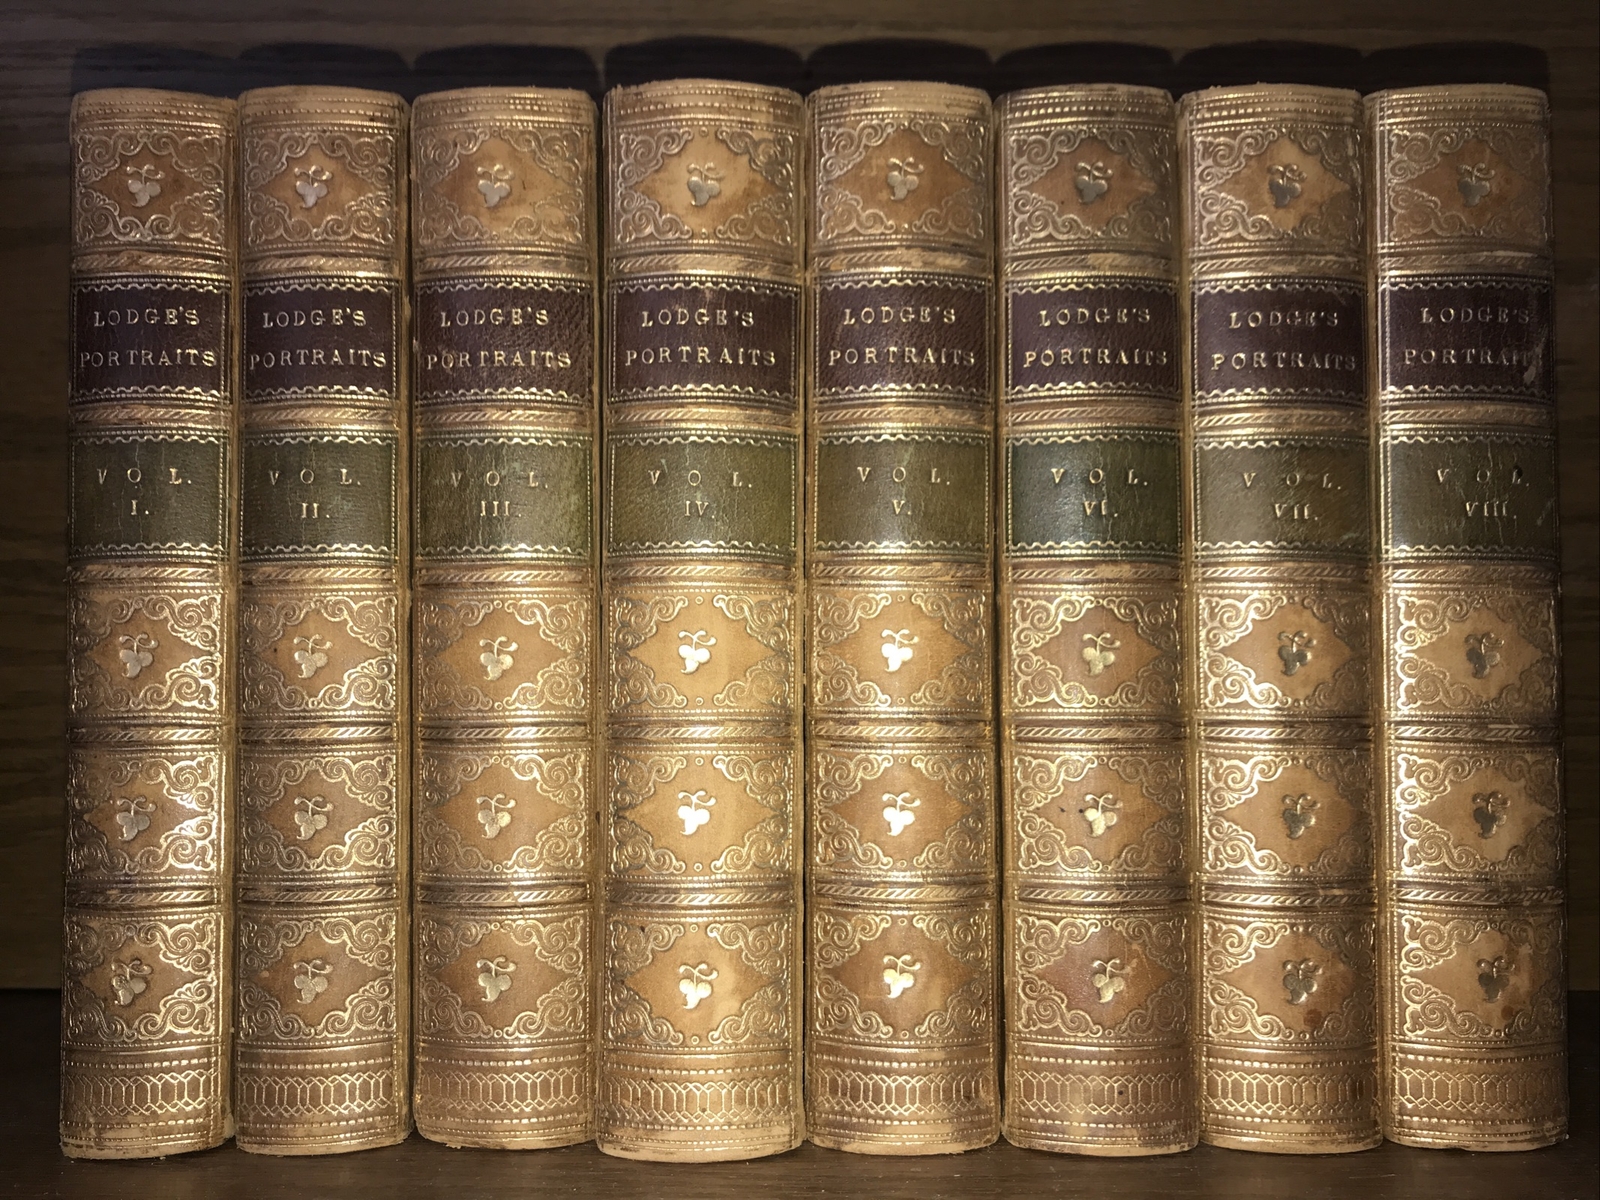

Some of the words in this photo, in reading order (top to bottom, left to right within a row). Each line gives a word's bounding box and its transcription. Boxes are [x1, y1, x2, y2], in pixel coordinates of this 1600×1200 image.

[94, 307, 200, 327] LODGE'S
[263, 308, 367, 328] LODGE'S
[440, 308, 550, 327] LODGE'S
[642, 310, 755, 327] LODGE'S
[843, 308, 956, 325] LODGE'S
[1040, 309, 1151, 326] LODGE'S
[1229, 312, 1338, 329] LODGE'S
[1421, 308, 1530, 324] LODGE'S
[80, 349, 217, 368] PORTRAITS
[250, 349, 386, 370] PORTRAITS
[427, 351, 572, 369] PORTRAITS
[625, 347, 775, 367] PORTRAITS
[829, 348, 975, 366] PORTRAITS
[1024, 349, 1168, 368] PORTRAITS
[1211, 352, 1356, 371] PORTRAITS
[131, 500, 149, 515] I.
[301, 503, 330, 518] II.
[480, 501, 522, 517] III.
[684, 501, 715, 519] IV.
[893, 500, 911, 515] V.
[1084, 501, 1118, 517] VI.
